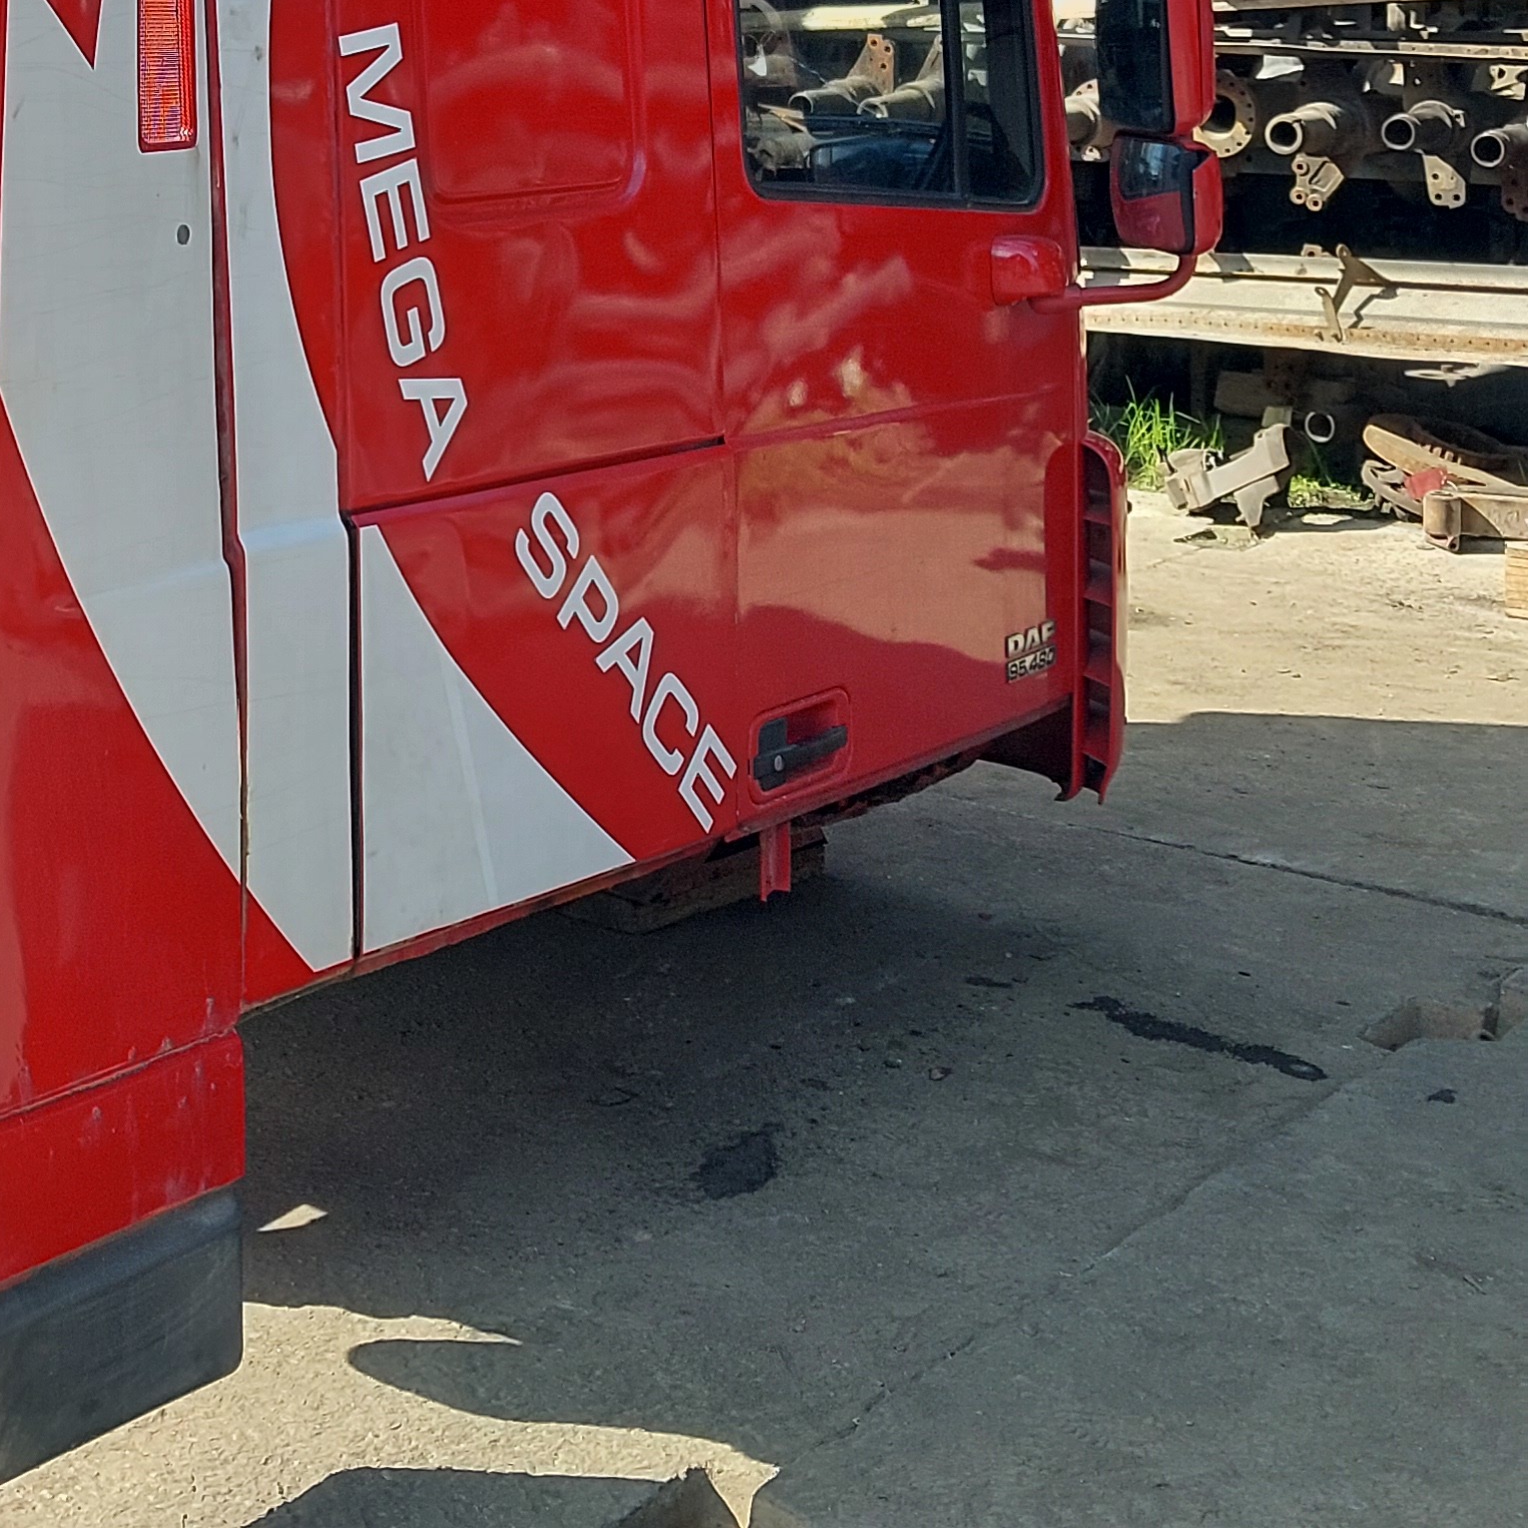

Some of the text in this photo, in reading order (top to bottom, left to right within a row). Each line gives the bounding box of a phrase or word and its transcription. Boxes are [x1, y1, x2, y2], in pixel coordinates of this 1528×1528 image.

[338, 22, 737, 834] MEGA SPACE
[1005, 620, 1056, 658] DAF
